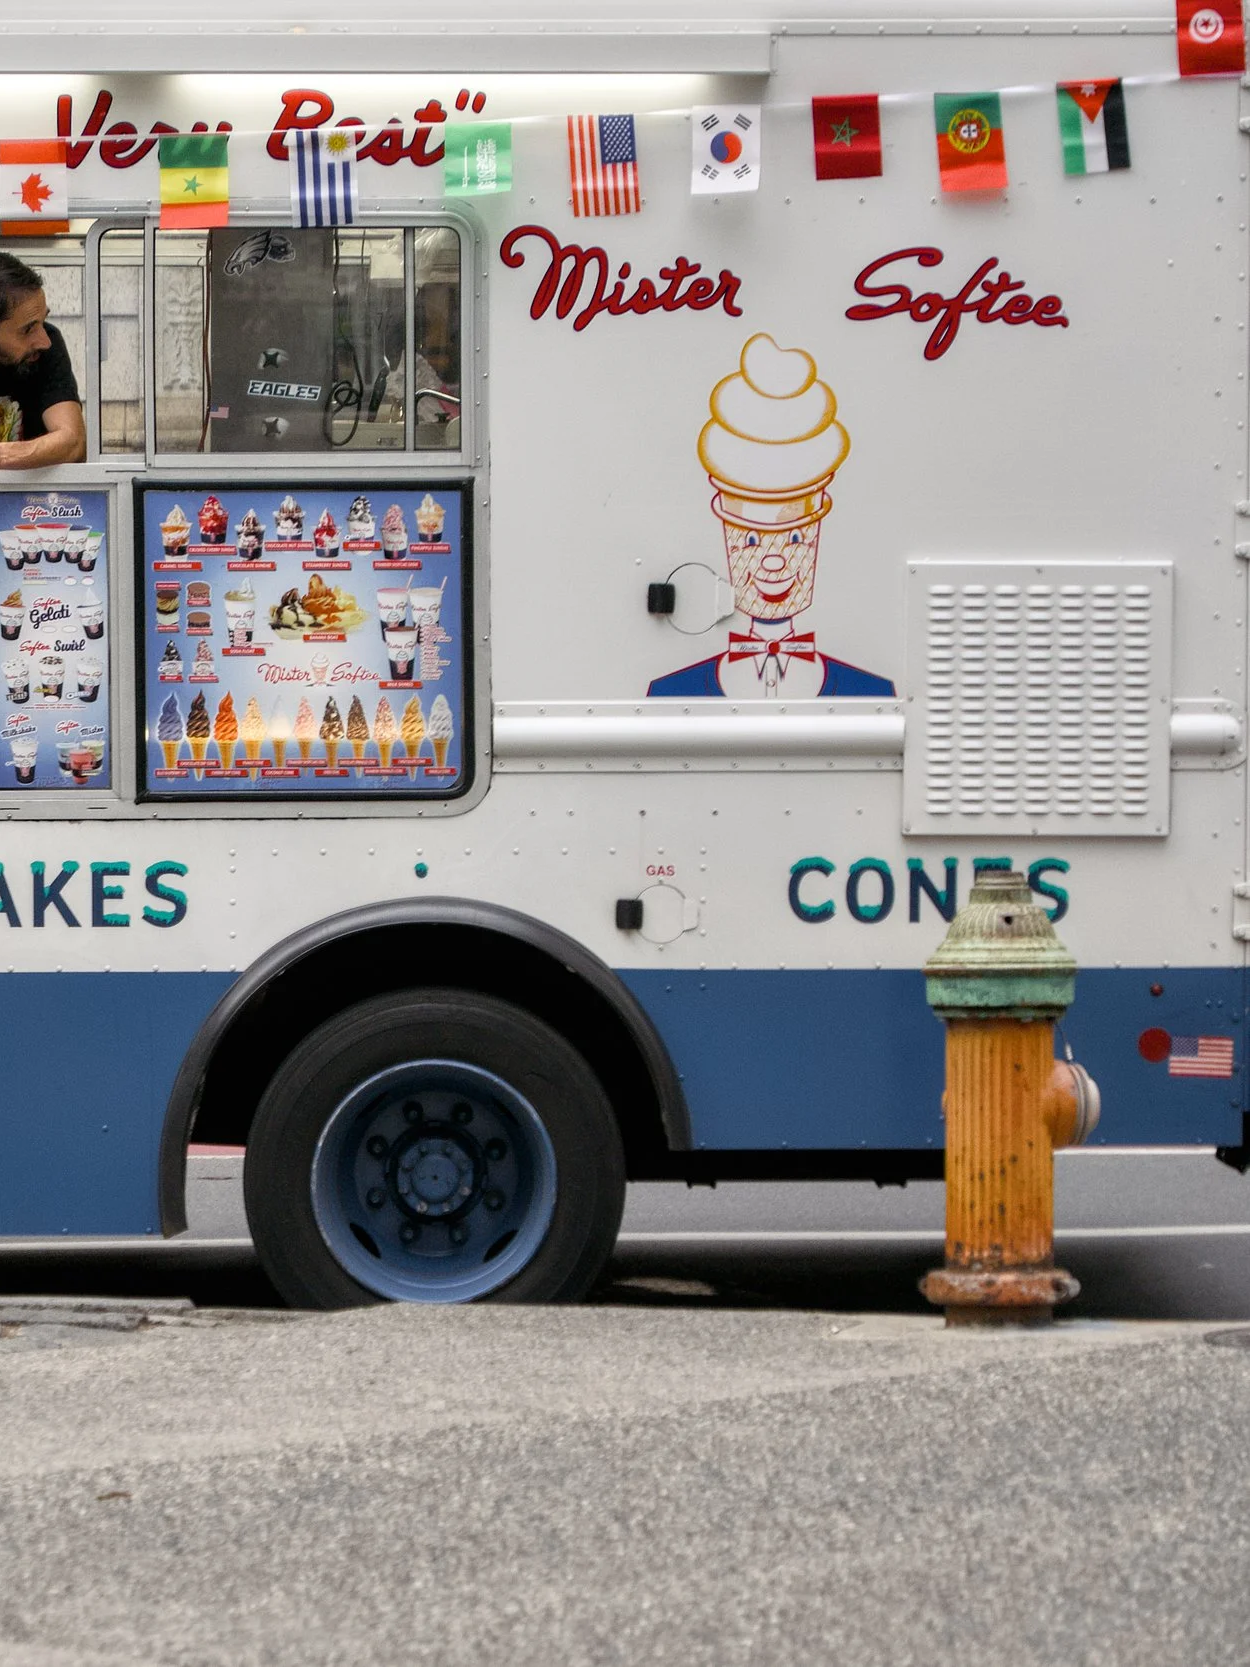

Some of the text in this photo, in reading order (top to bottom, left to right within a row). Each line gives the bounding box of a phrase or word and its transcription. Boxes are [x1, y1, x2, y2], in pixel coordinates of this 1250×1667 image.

[56, 90, 232, 169] Ver
[500, 225, 1069, 361] Mister Softee
[249, 381, 320, 399] EAGLES
[51, 505, 82, 518] Slush
[30, 605, 71, 629] Gelati
[54, 639, 86, 652] Swirl
[257, 661, 382, 684] Mister Softee
[646, 864, 675, 876] GAS
[788, 856, 1070, 924] CONS
